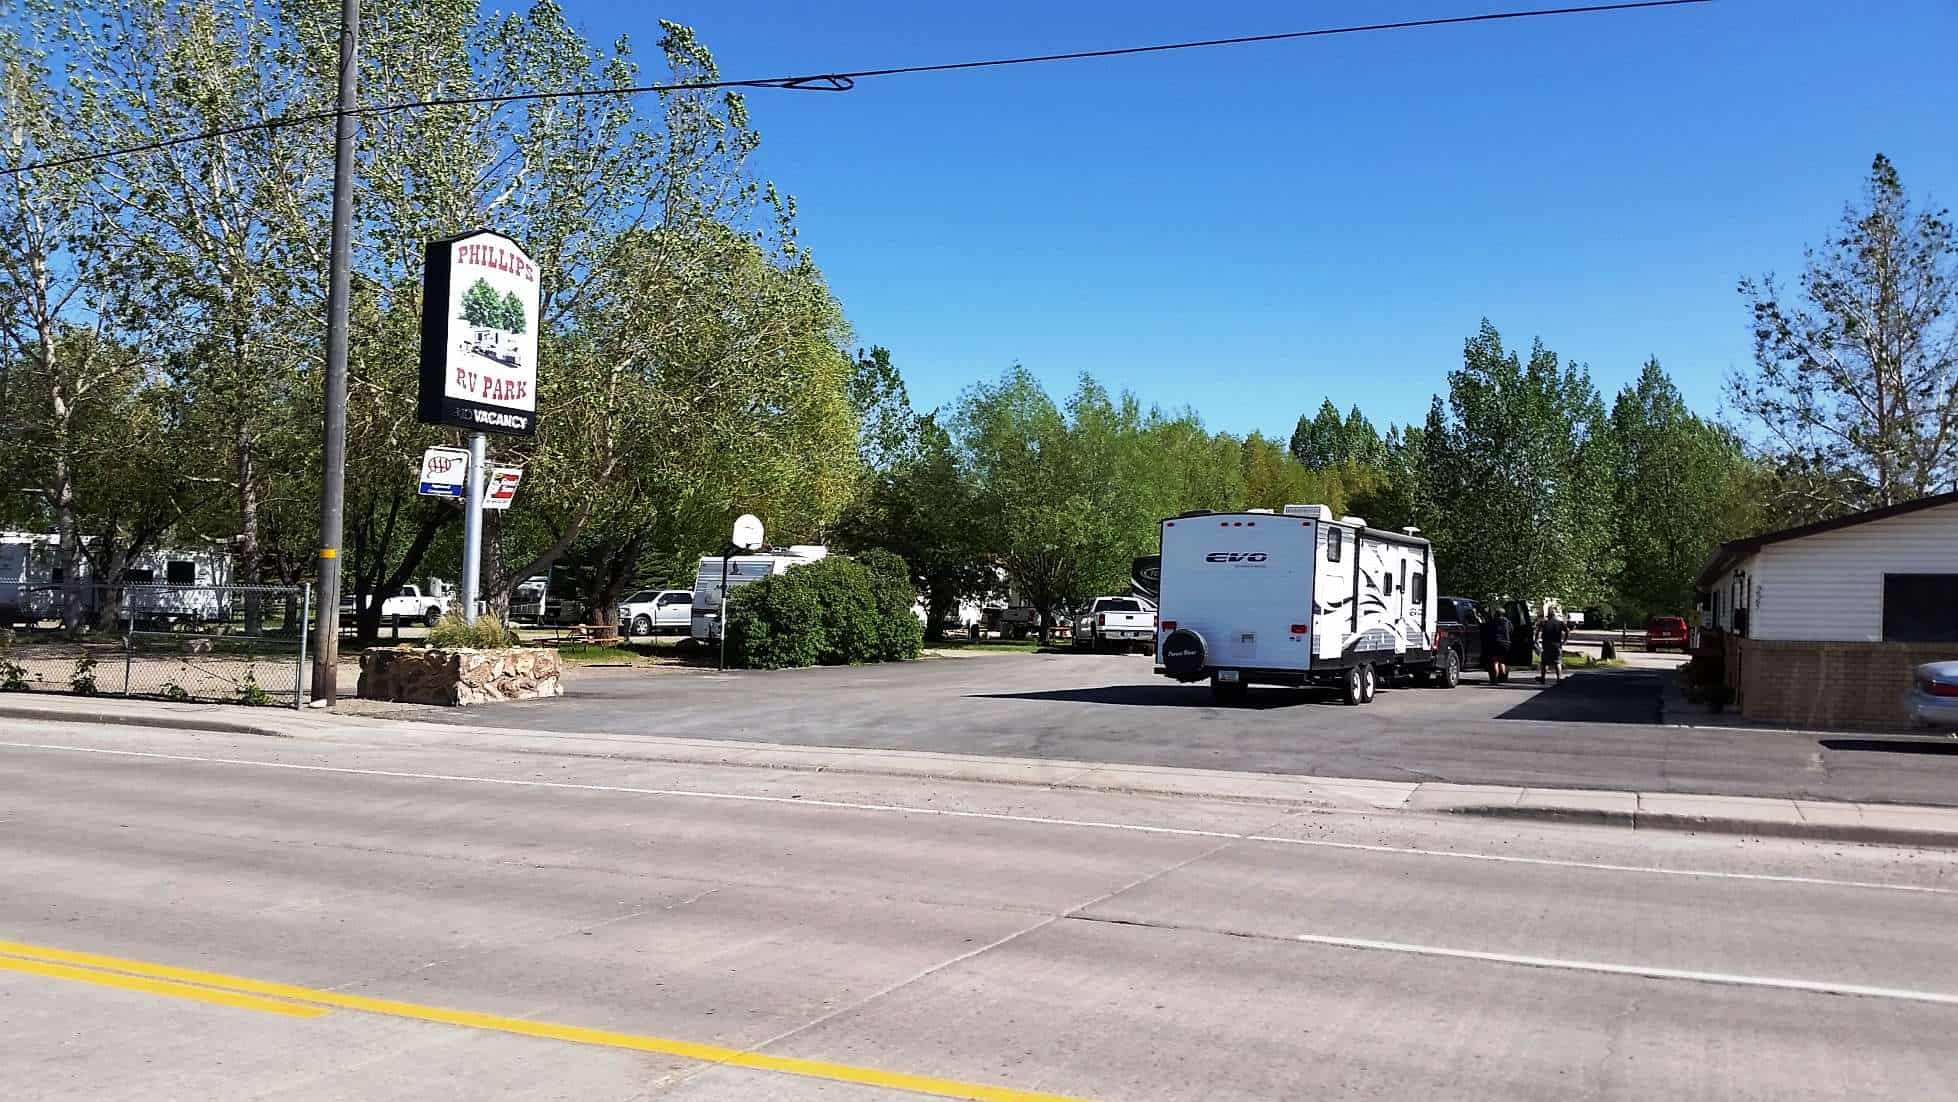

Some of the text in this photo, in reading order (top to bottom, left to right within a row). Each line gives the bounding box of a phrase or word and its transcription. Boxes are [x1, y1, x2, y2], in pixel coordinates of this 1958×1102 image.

[457, 244, 534, 282] PHILLIPS
[456, 367, 528, 401] RV PARK
[473, 408, 529, 431] VACANCY
[1205, 552, 1267, 563] EVO
